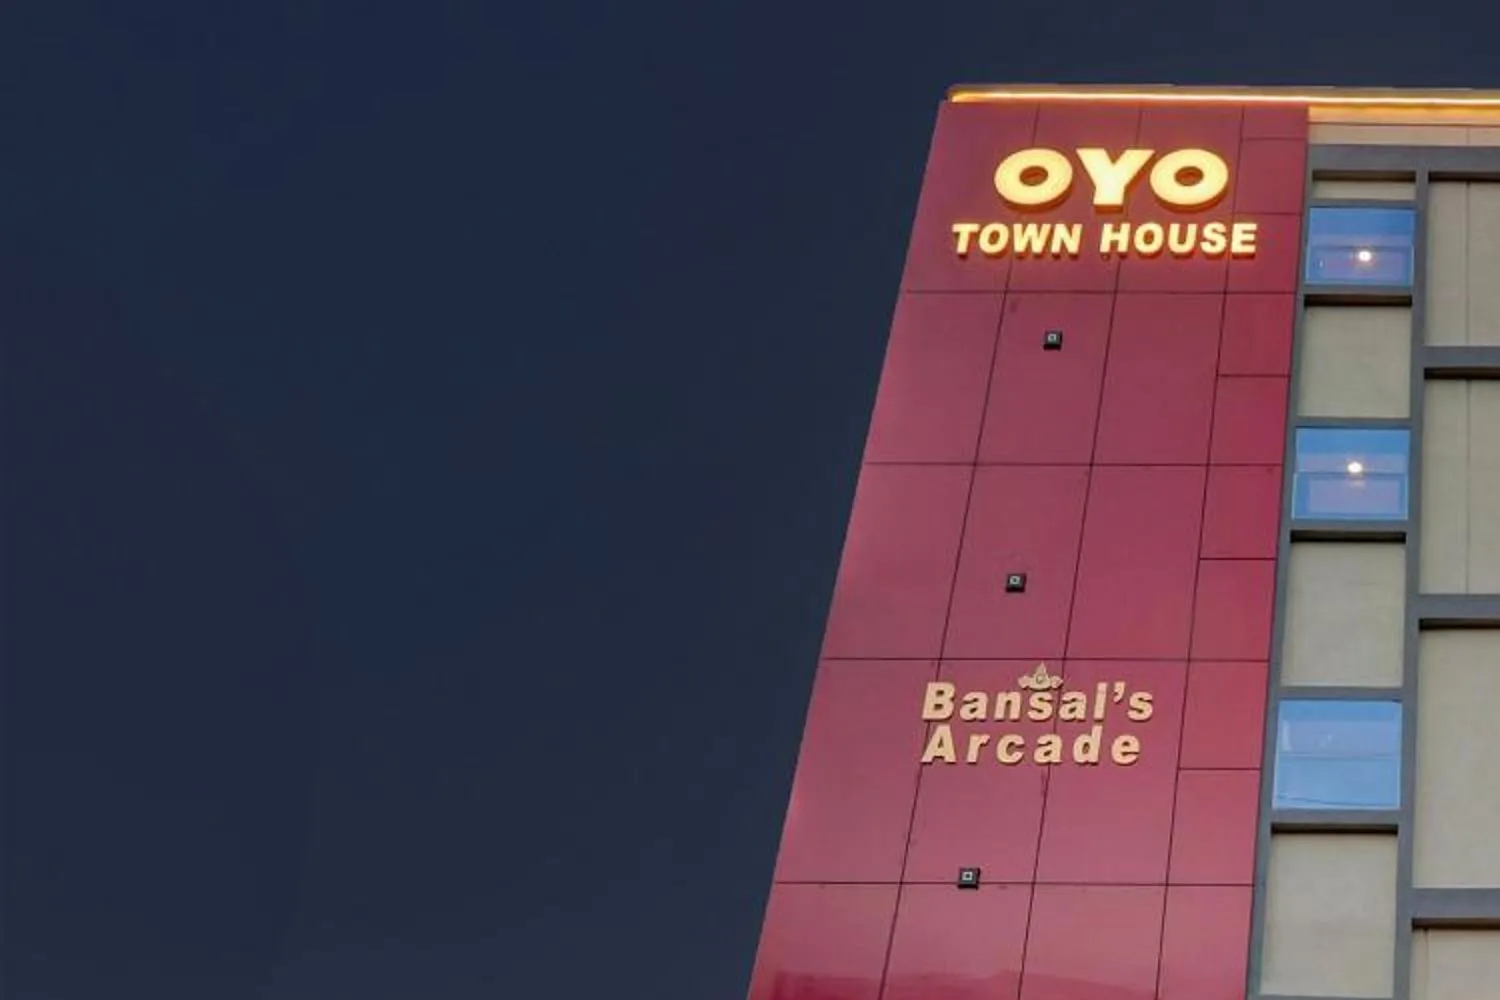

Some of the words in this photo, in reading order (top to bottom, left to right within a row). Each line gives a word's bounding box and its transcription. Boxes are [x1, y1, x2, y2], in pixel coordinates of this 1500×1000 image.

[994, 147, 1229, 208] OYO
[952, 223, 1082, 256] TOWN
[1100, 223, 1257, 256] HOUSE
[921, 682, 1153, 721] Bansal's
[920, 724, 1141, 764] Arcade
